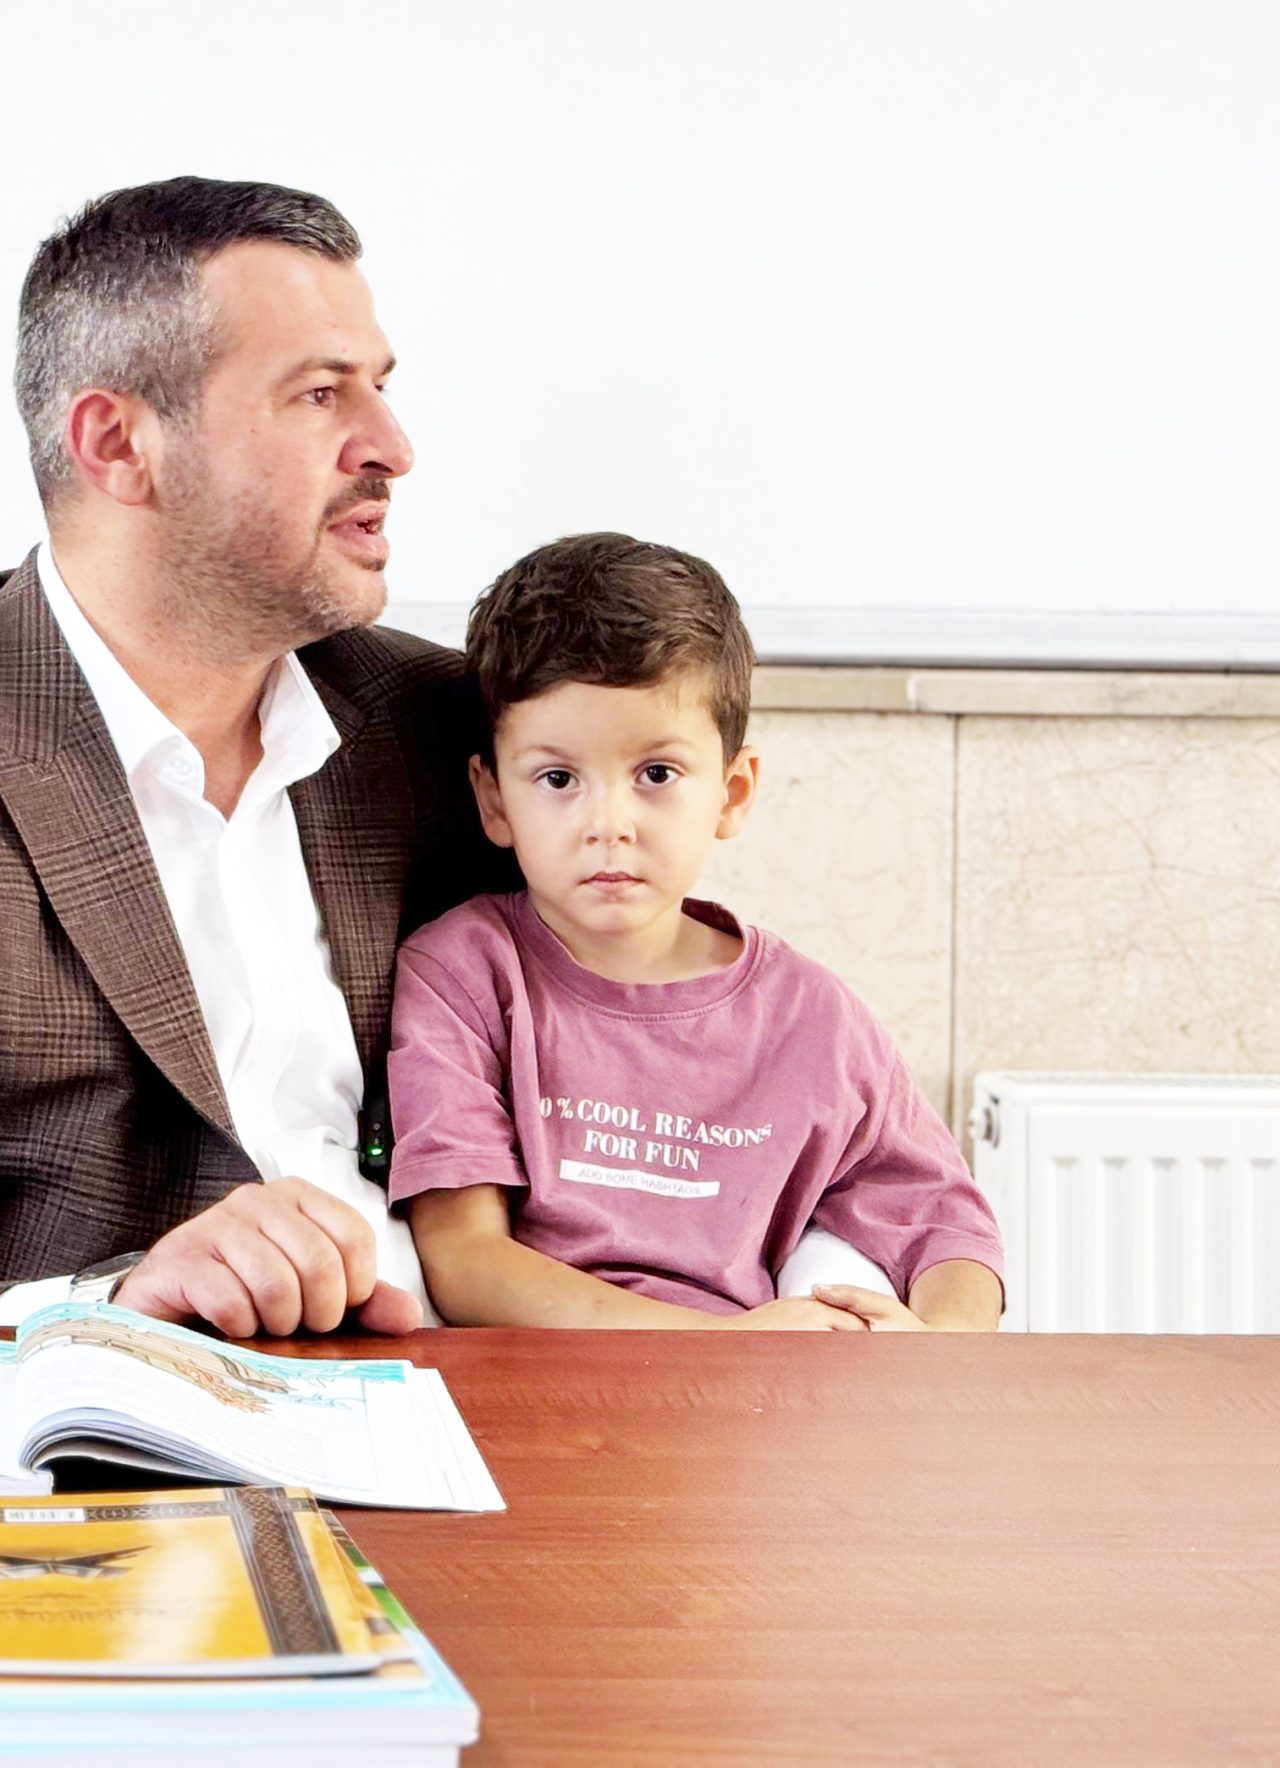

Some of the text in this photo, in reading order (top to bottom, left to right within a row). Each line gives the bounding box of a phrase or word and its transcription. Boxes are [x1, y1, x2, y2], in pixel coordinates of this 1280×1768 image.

[577, 1099, 646, 1133] COOL
[584, 1129, 700, 1172] FOR FUN
[578, 1167, 602, 1181] ADD
